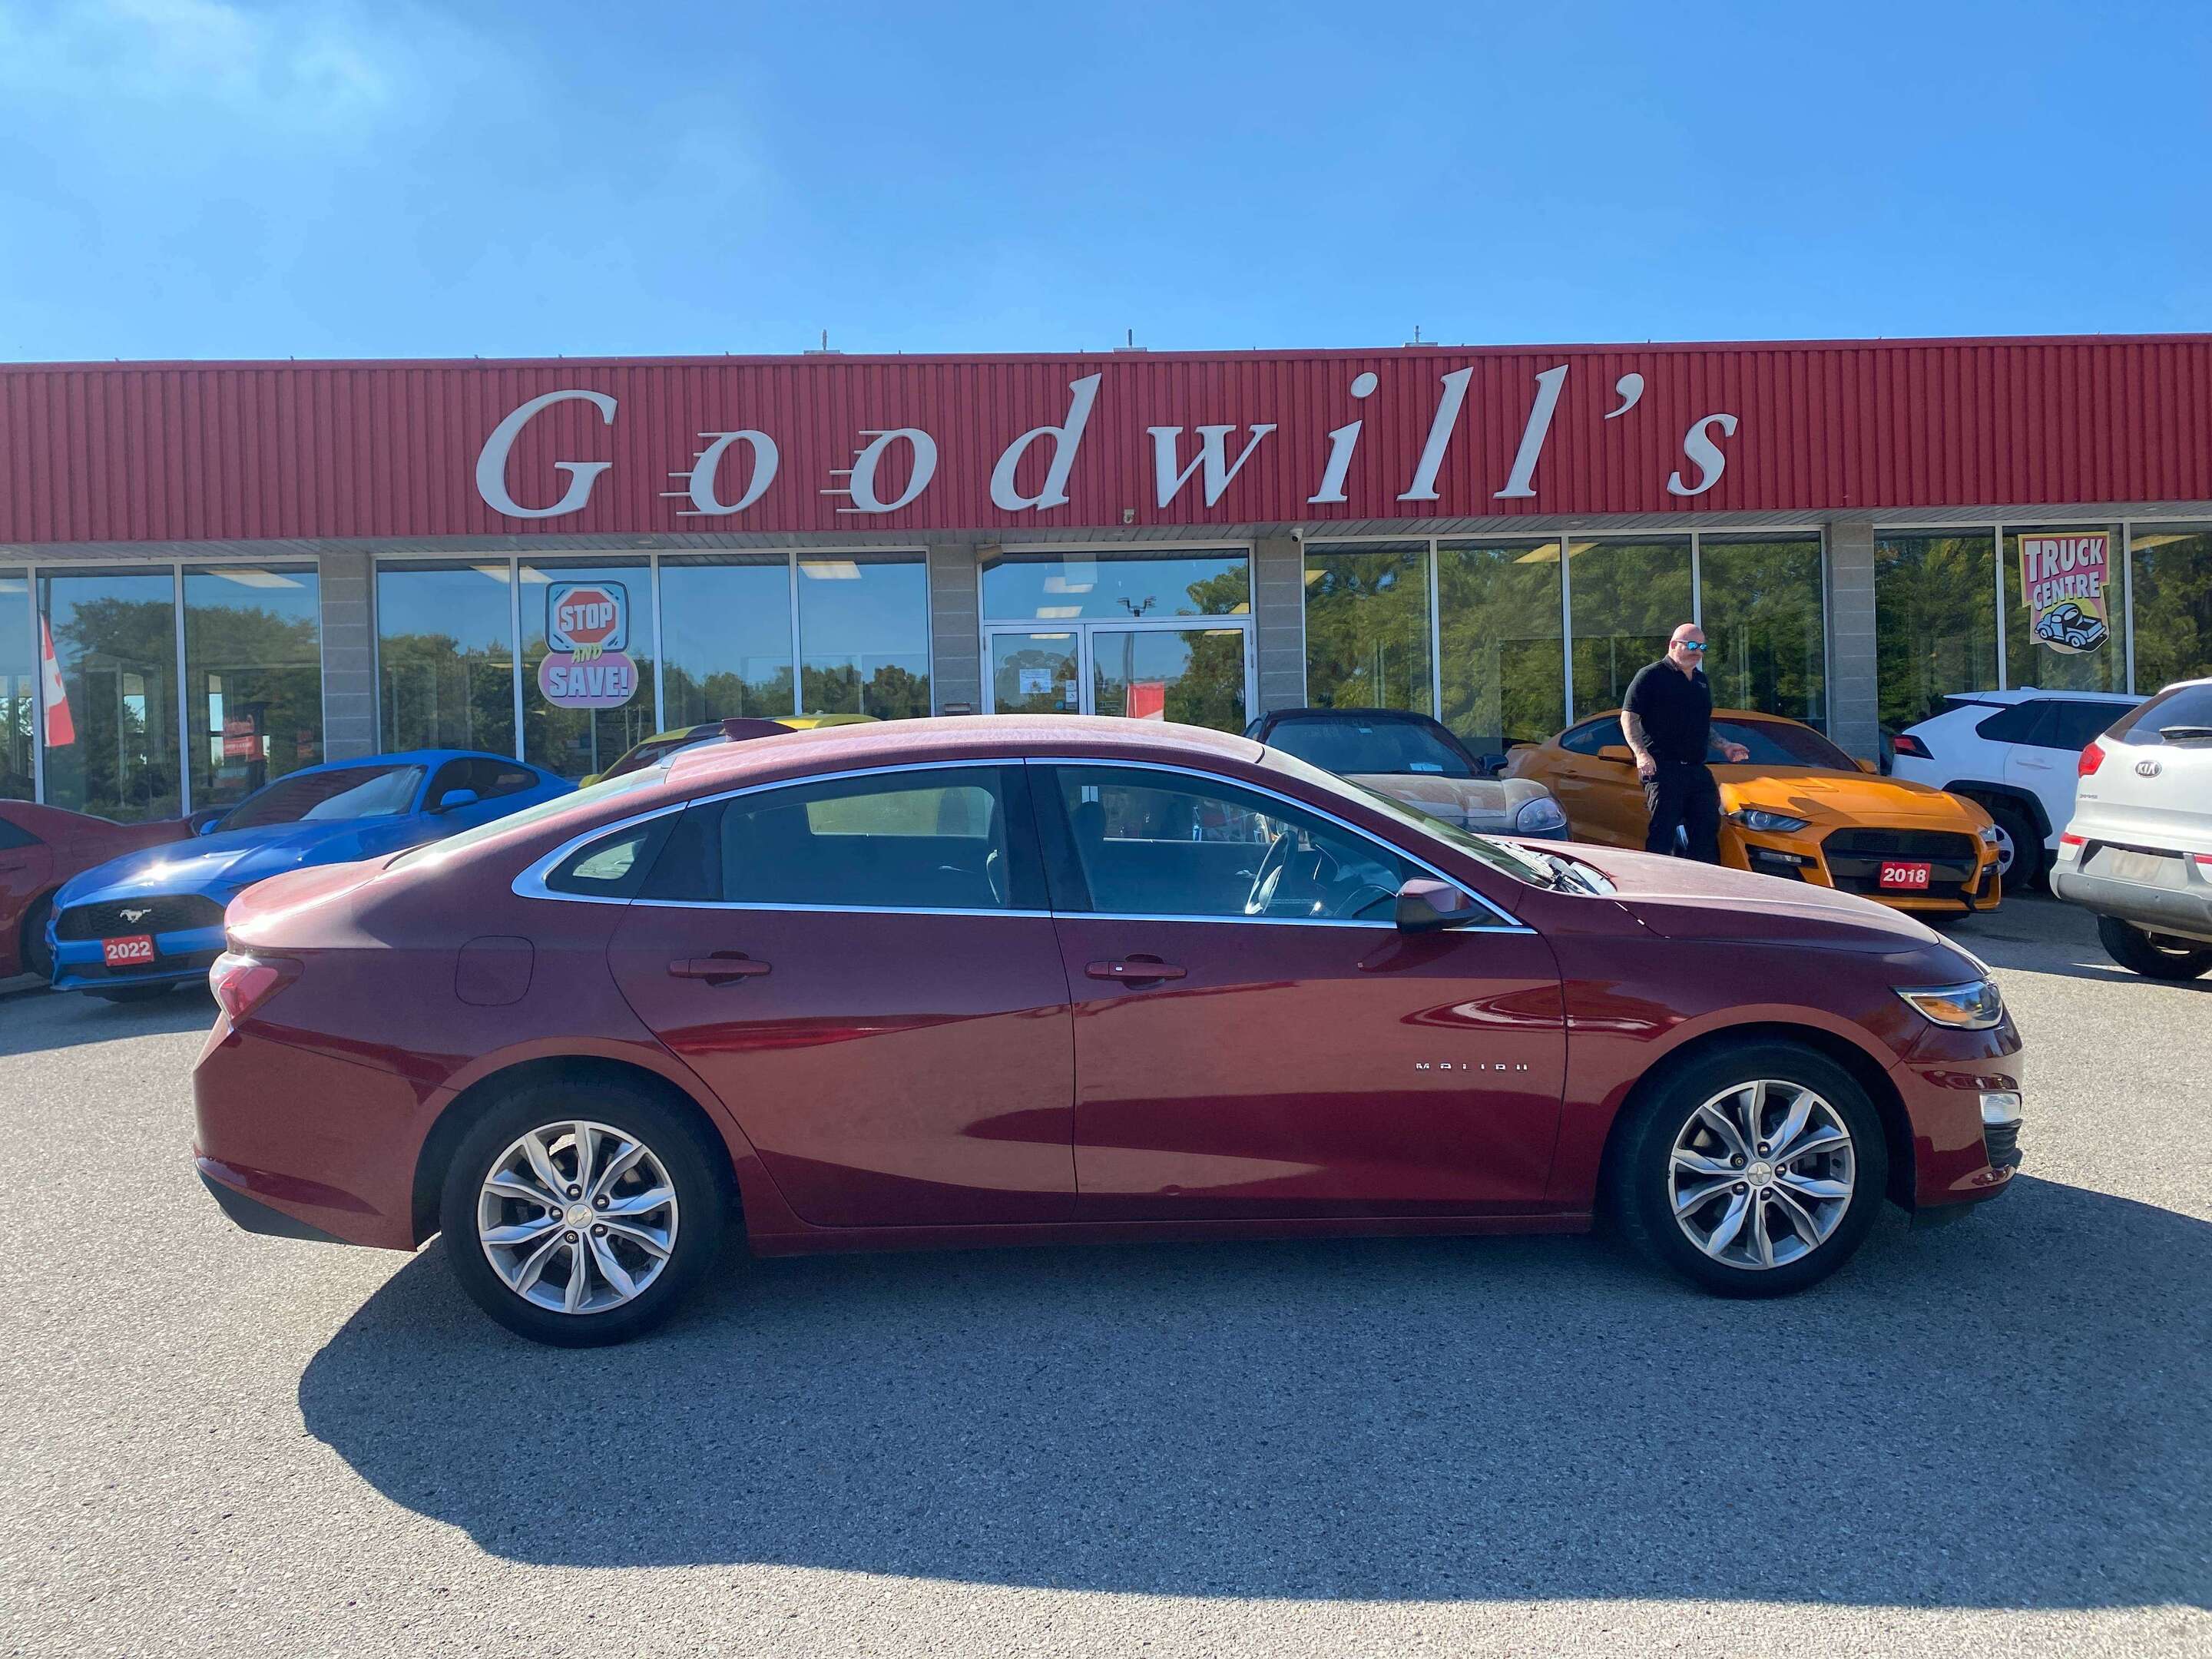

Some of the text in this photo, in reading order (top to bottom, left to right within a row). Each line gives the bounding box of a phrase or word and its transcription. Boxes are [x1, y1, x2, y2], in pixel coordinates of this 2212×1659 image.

[475, 365, 1739, 519] Goodwill's
[2025, 538, 2104, 583] TRUCK
[2033, 571, 2101, 611] CENTRE
[560, 602, 613, 632] STOP
[571, 644, 603, 664] AND
[548, 666, 630, 698] SAVE!
[1883, 868, 1928, 883] 2018
[106, 941, 152, 960] 2022
[1416, 1062, 1528, 1071] MALIBU
